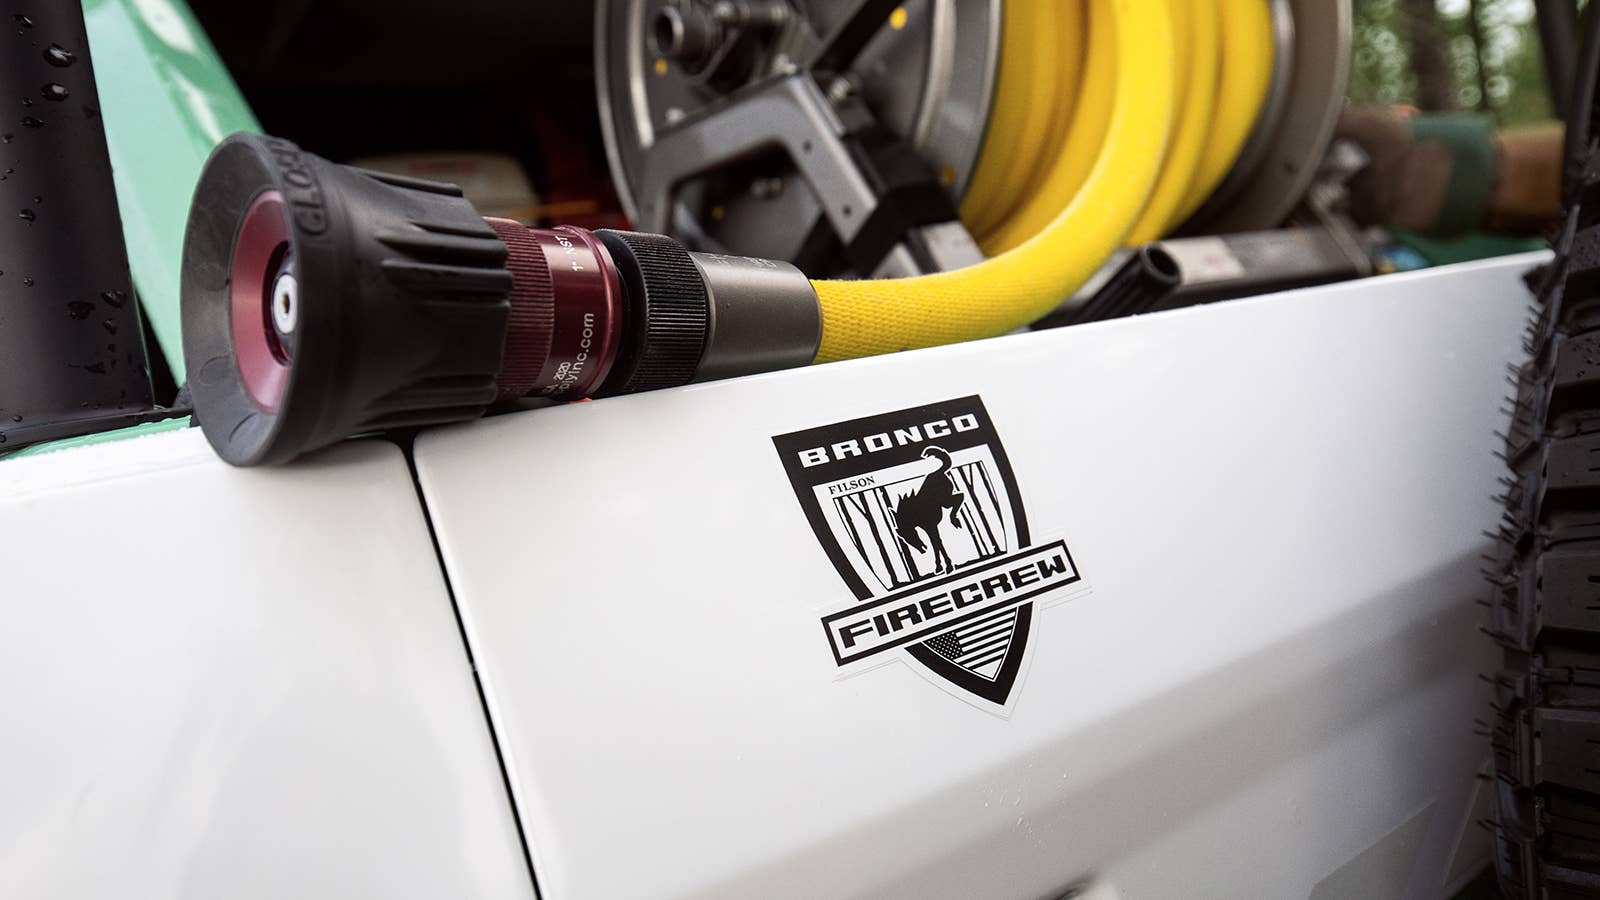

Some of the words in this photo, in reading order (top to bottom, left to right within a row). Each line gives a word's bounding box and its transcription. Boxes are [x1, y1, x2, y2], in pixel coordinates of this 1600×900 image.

[798, 413, 980, 468] BRONCO
[828, 475, 876, 495] FILSON
[838, 554, 1067, 649] FIRECREW
